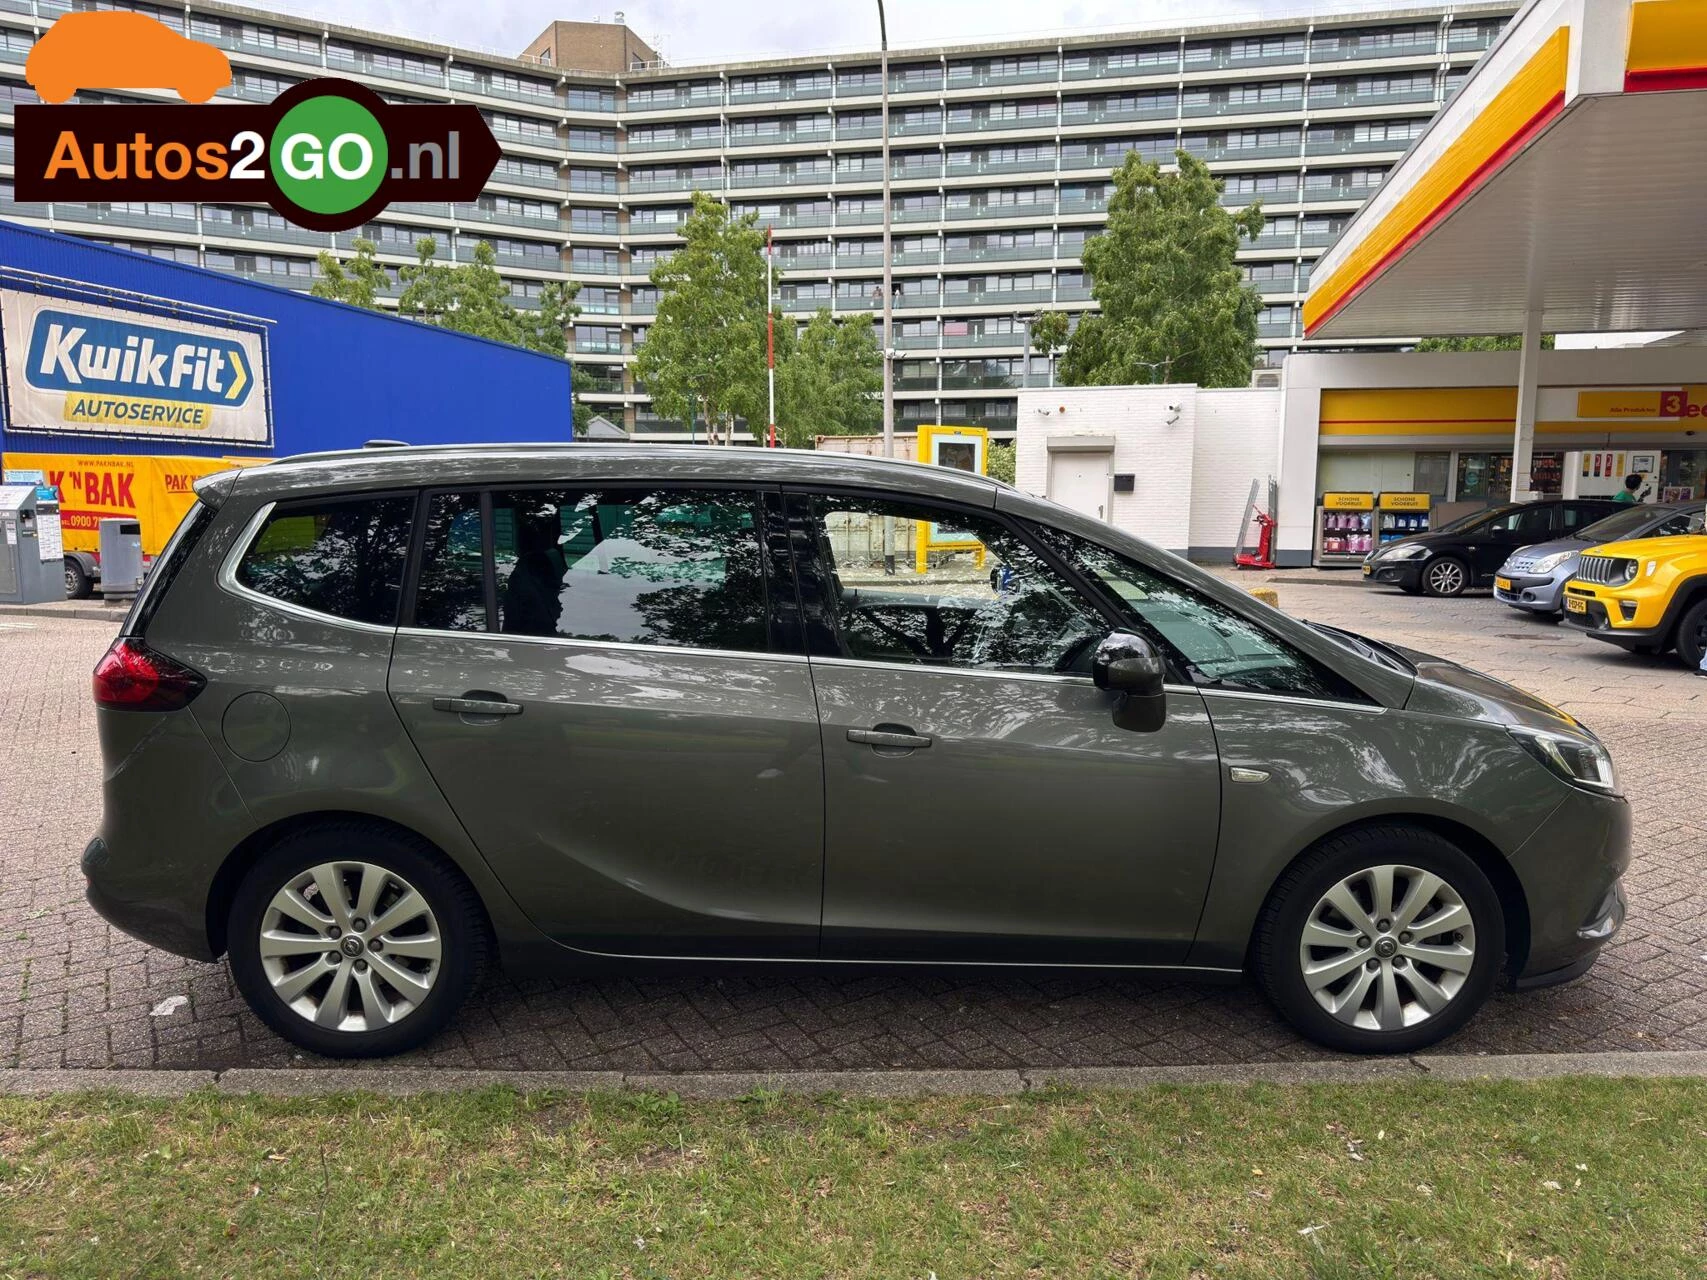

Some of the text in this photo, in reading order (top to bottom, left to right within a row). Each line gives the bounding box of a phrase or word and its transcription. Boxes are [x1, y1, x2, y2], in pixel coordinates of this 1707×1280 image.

[72, 399, 203, 424] AUTOSERVICE
[84, 472, 137, 509] BAK
[165, 474, 189, 491] PAK
[70, 515, 92, 528] 0900
